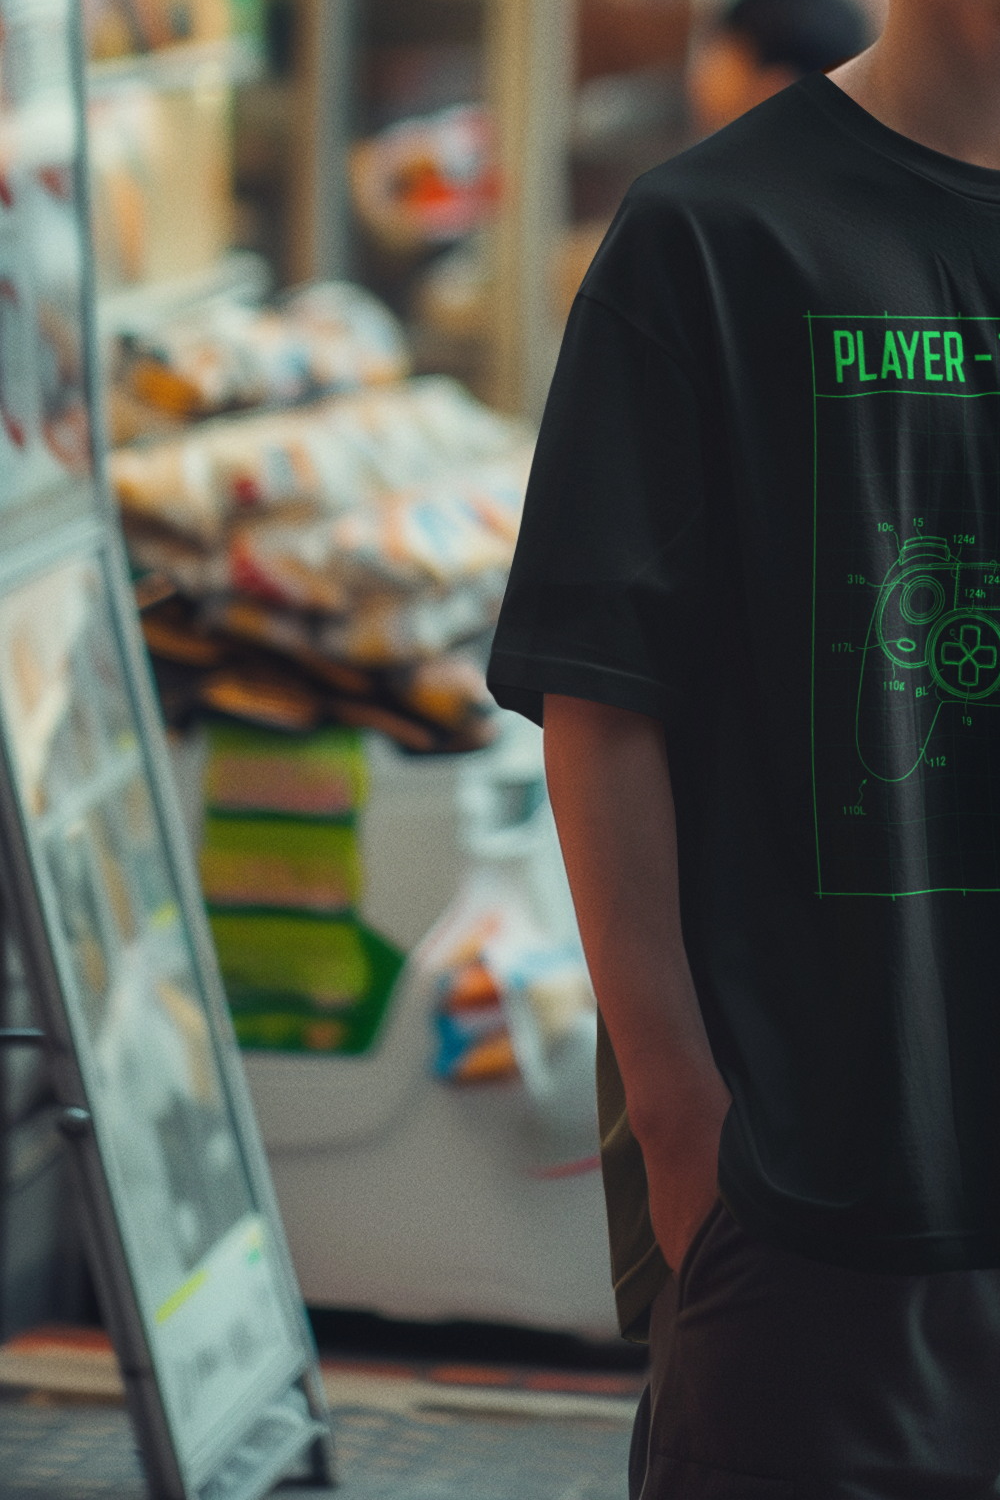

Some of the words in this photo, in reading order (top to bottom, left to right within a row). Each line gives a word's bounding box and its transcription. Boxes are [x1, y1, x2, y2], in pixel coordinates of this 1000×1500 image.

[877, 522, 894, 533] 10c
[912, 517, 924, 527] 15
[953, 534, 975, 545] 124d
[847, 574, 866, 585] 31b
[964, 588, 986, 599] 124h
[831, 642, 855, 653] 117L
[882, 679, 906, 692] 110g
[915, 685, 929, 698] BL
[961, 715, 972, 726] 19
[930, 755, 947, 768] 112
[843, 805, 867, 816] 110L
